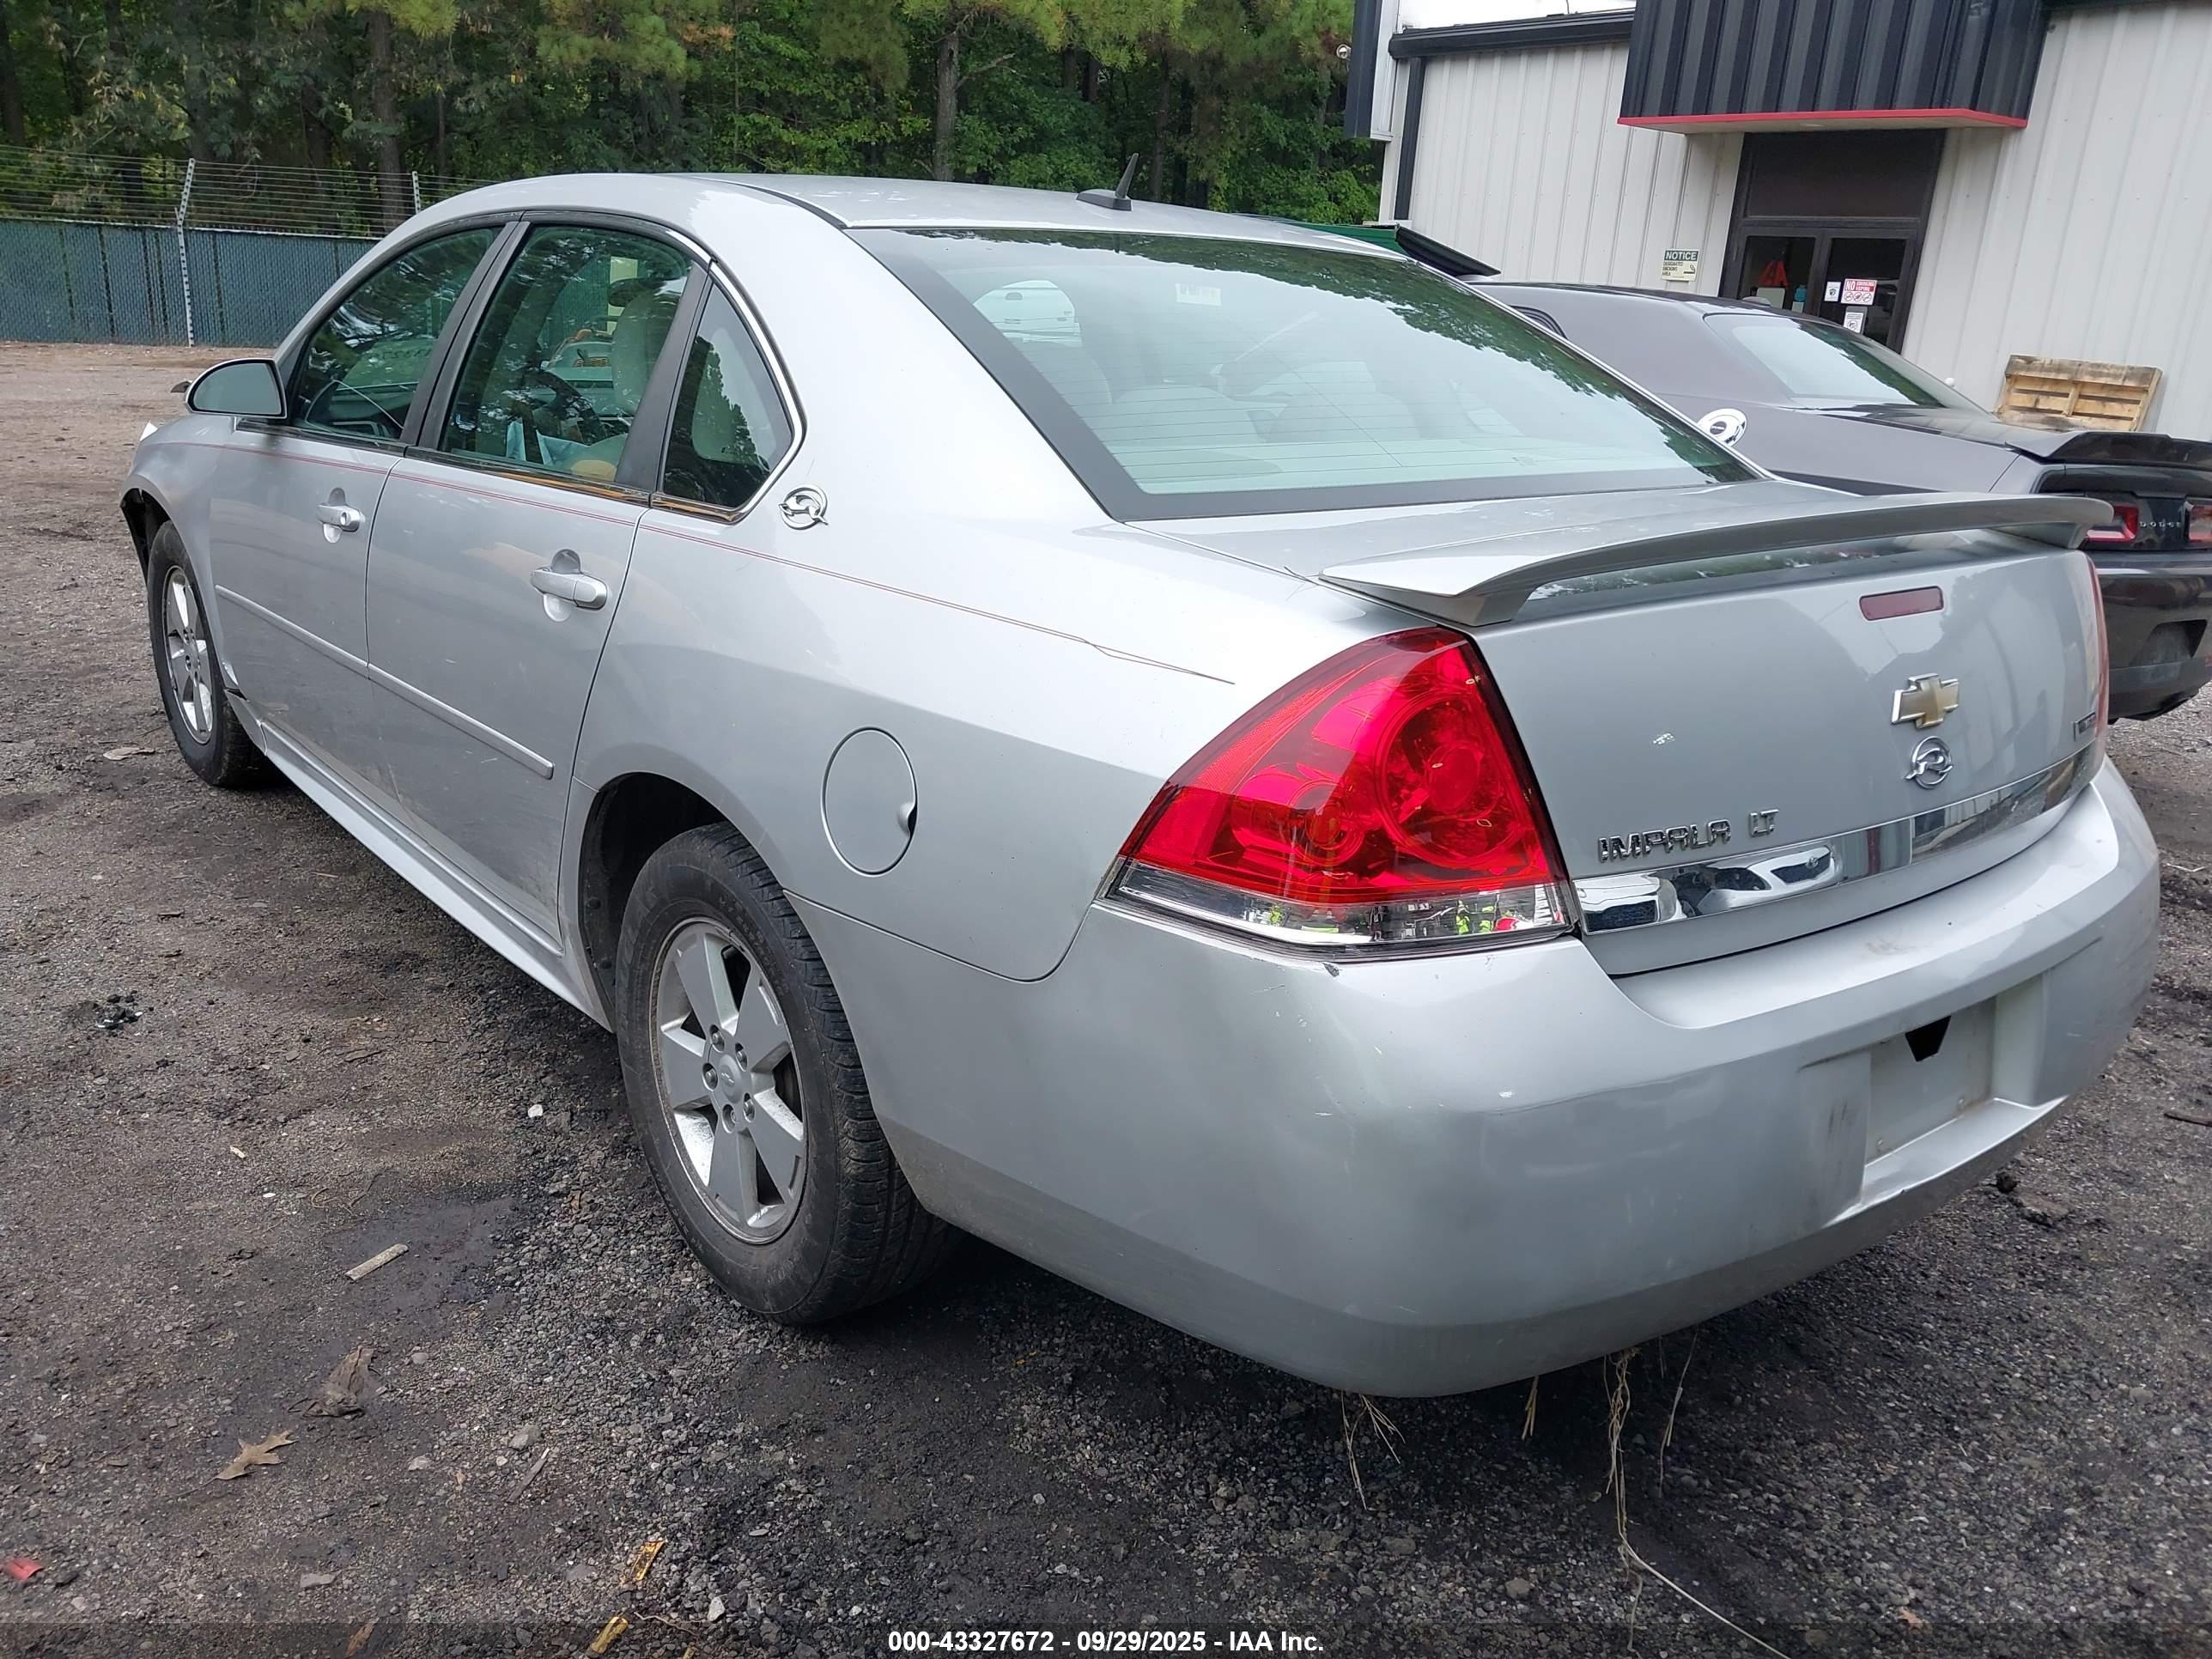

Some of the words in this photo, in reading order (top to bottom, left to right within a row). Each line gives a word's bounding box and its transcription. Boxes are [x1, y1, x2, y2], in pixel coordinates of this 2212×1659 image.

[1666, 252, 1697, 260] NOTICE
[1845, 281, 1856, 290] NO
[1598, 819, 1732, 863] IMPALA
[1748, 809, 1780, 837] LT
